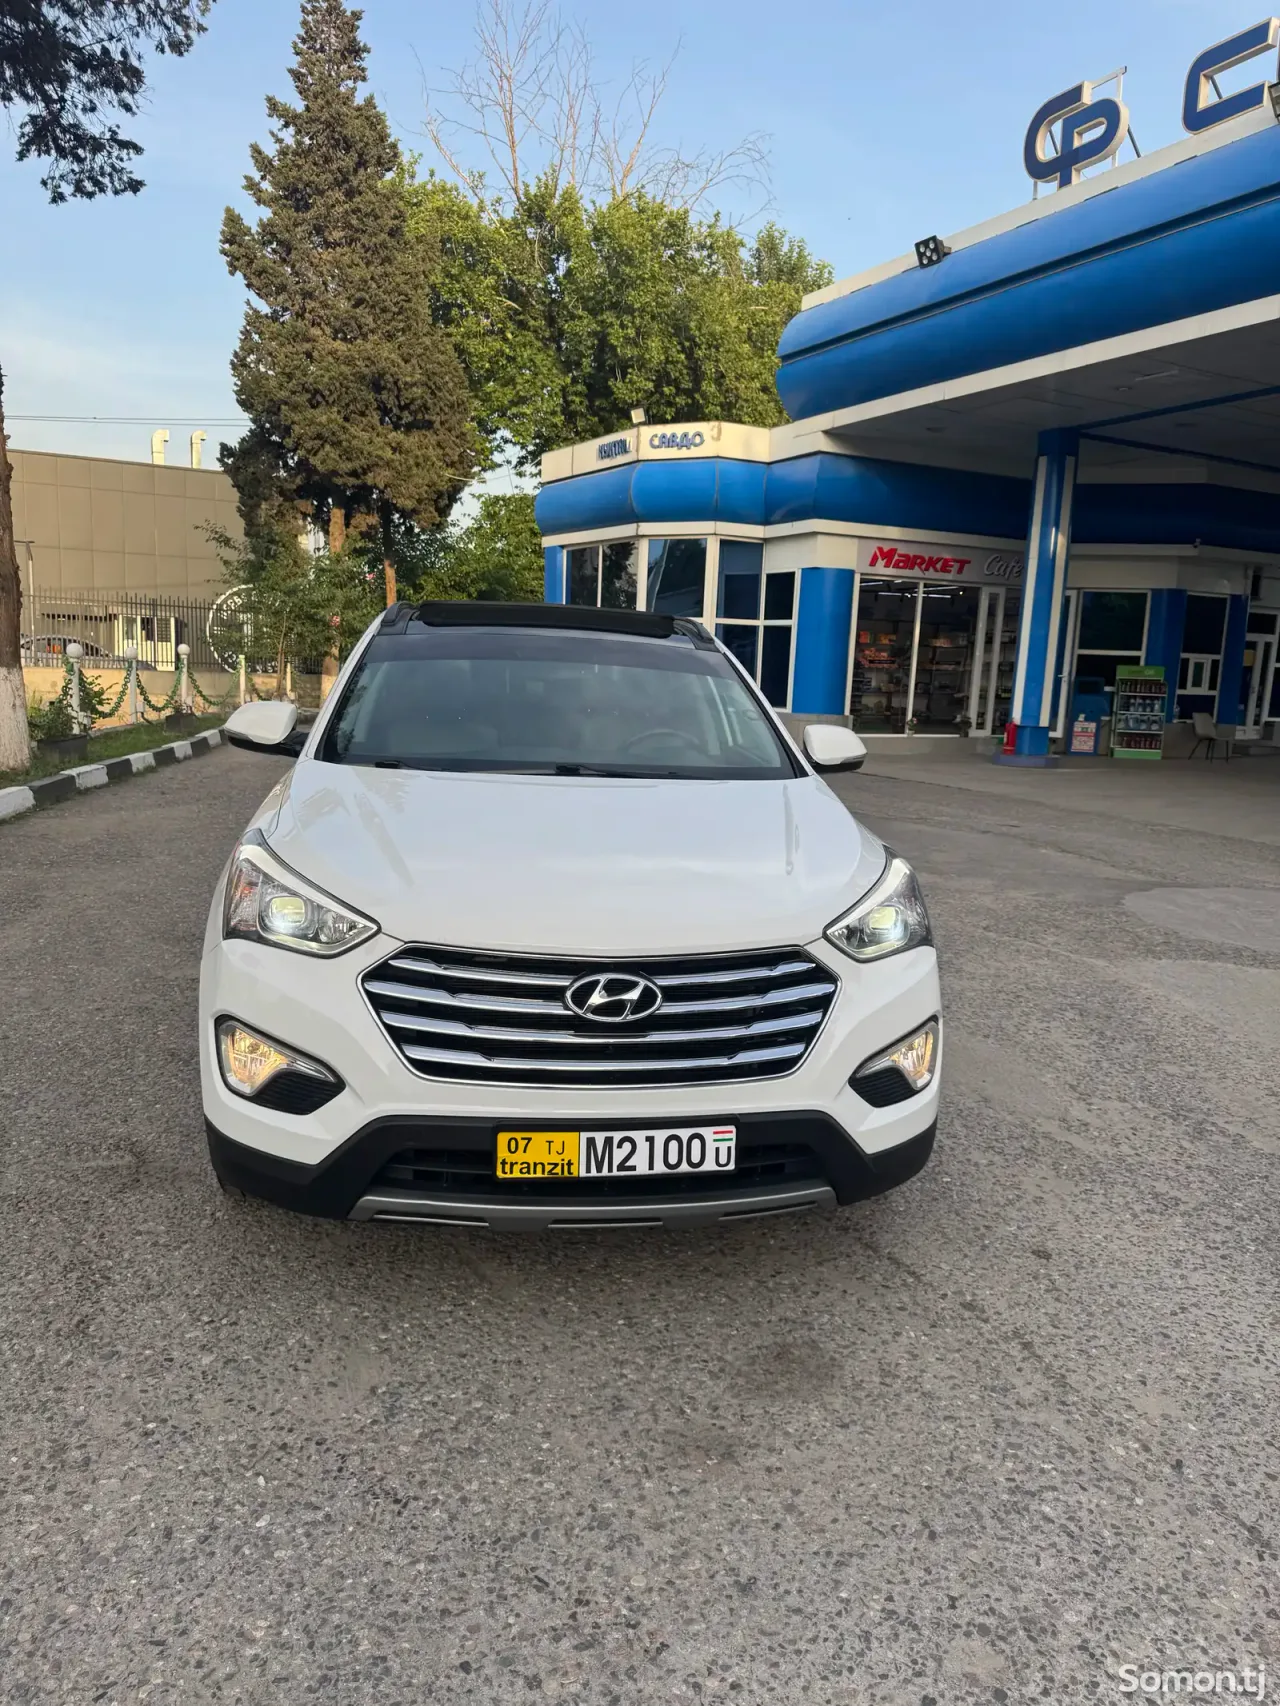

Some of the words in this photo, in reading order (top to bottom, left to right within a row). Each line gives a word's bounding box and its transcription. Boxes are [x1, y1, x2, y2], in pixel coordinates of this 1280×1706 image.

[507, 1137, 532, 1154] 07
[546, 1140, 565, 1155] TJ
[585, 1132, 706, 1174] M2100
[500, 1158, 574, 1176] tranzit
